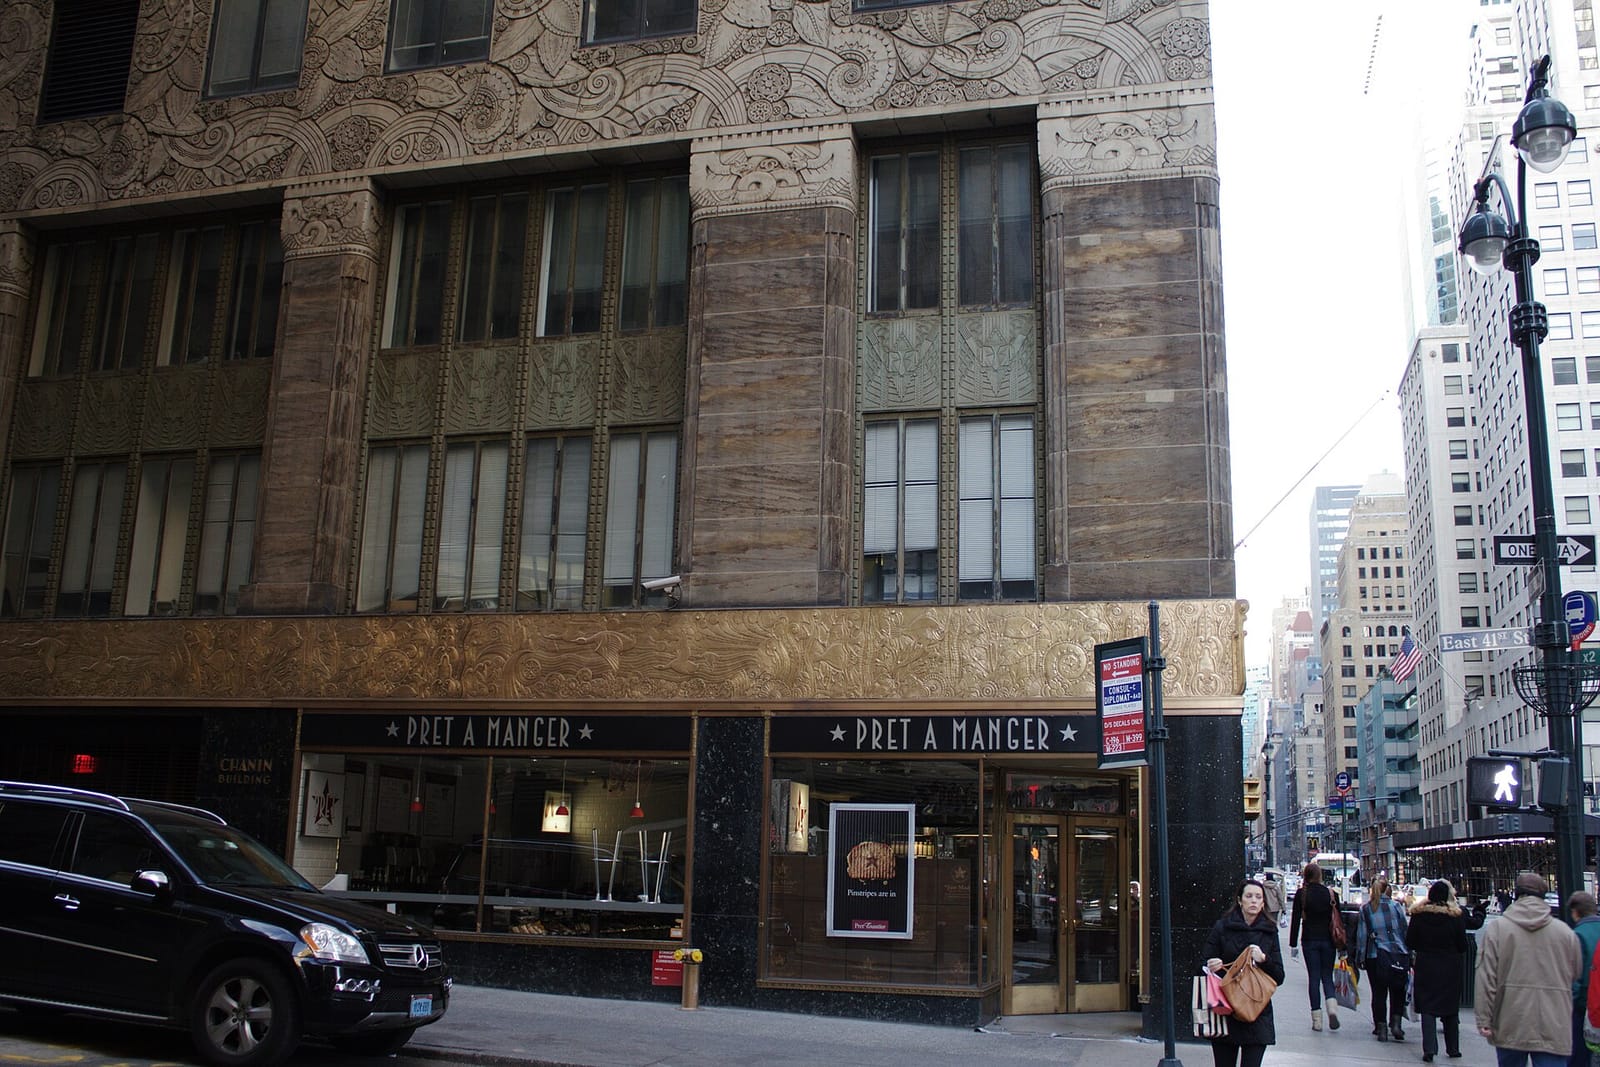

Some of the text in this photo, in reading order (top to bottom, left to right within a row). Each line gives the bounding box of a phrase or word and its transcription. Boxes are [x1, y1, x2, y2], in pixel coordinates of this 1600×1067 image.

[1508, 544, 1580, 556] ONE AY
[1441, 634, 1478, 650] East
[1513, 631, 1530, 645] St
[1103, 657, 1140, 671] NO STANDING
[1108, 684, 1136, 696] CONSUL-C
[1113, 720, 1130, 728] DECALS
[1131, 718, 1143, 726] ONLY
[407, 716, 570, 748] PRET A MANGER
[856, 717, 1049, 750] PRET A MANGER
[220, 758, 272, 772] CHANIN
[219, 774, 272, 785] BUILDING
[847, 889, 877, 899] Pinstripes
